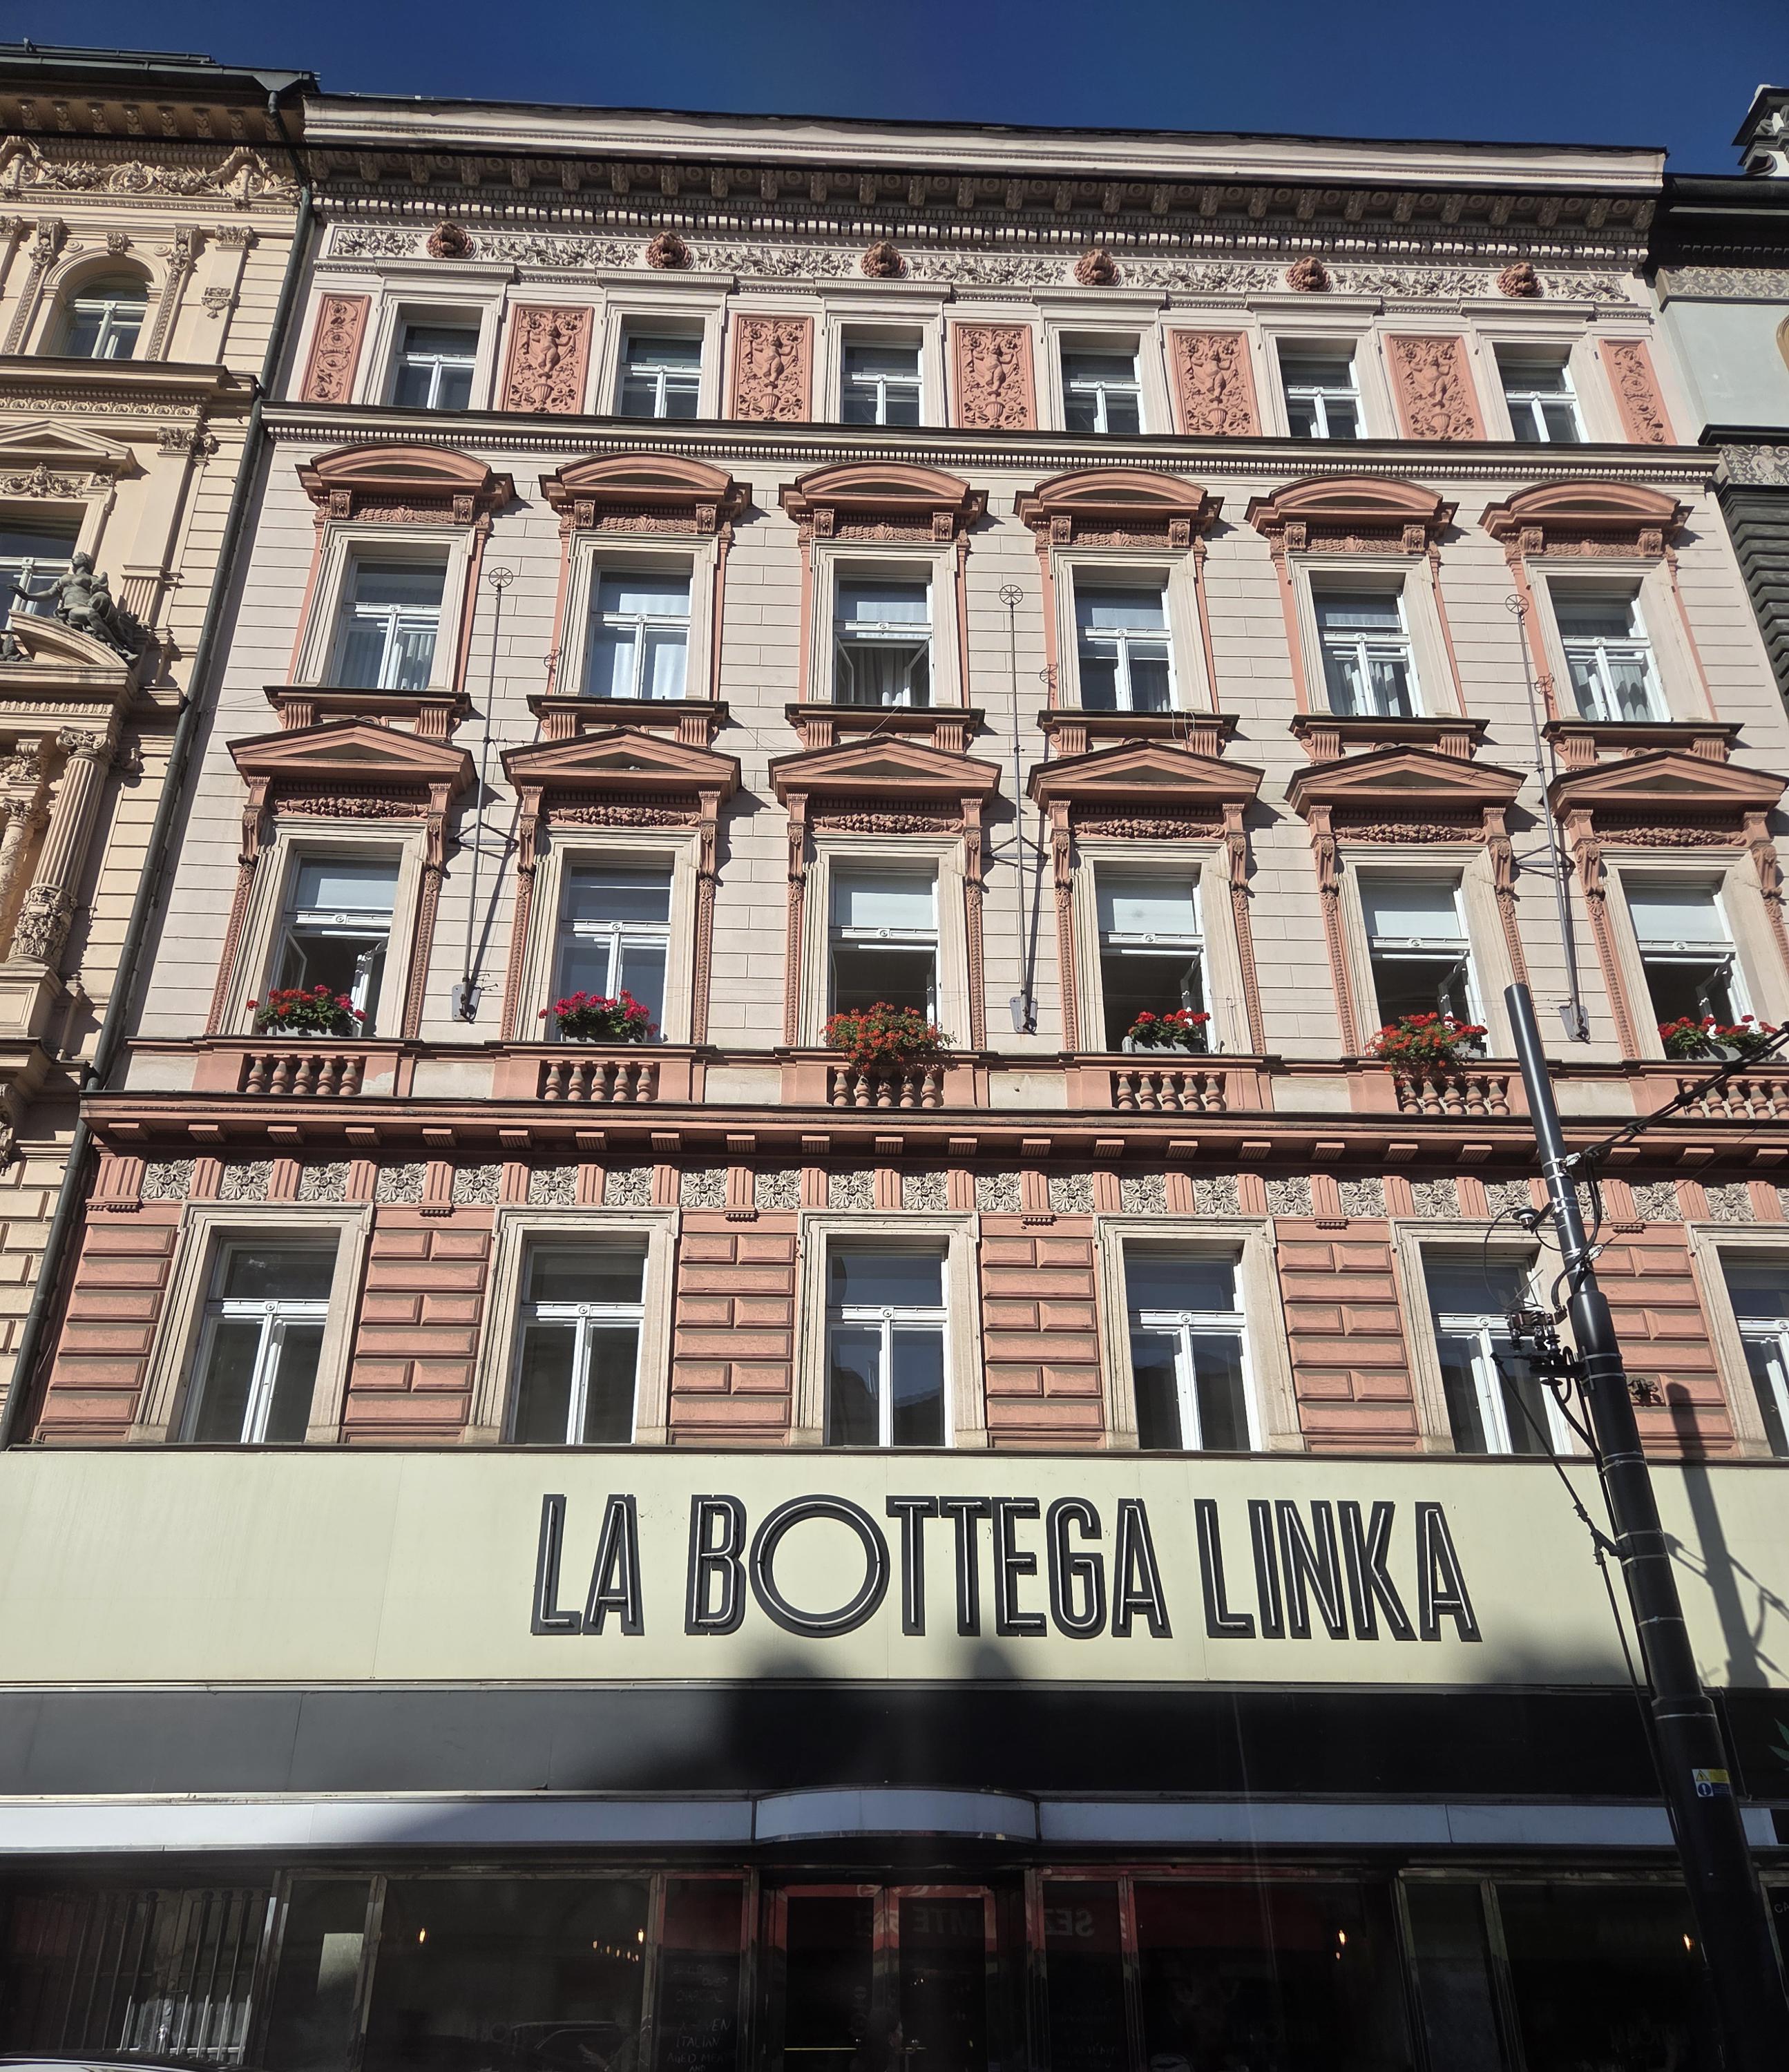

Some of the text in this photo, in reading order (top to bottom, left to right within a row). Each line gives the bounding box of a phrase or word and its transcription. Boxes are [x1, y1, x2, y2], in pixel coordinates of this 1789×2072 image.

[533, 1495, 1482, 1642] LA BOTTEGA LINKA
[676, 2033, 720, 2048] ITALIAN
